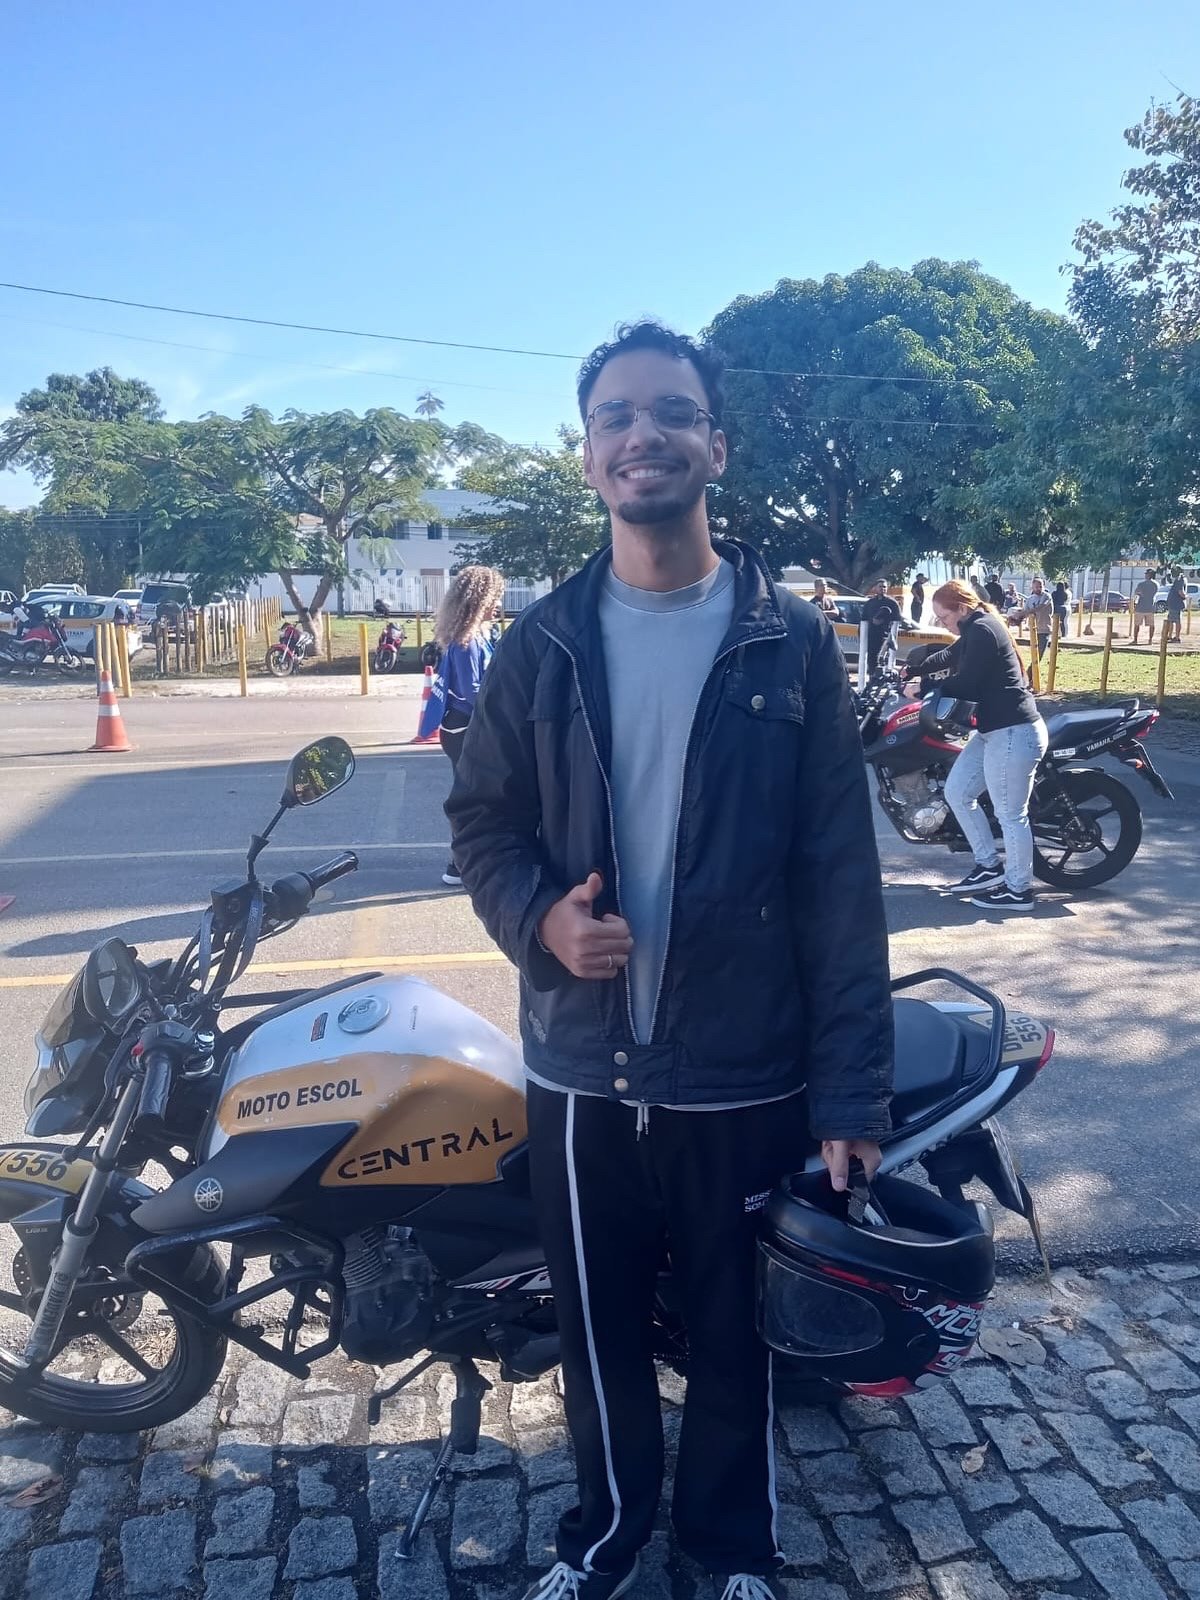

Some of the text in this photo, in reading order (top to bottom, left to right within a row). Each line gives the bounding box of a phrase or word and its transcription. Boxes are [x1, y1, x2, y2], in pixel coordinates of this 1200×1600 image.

[1086, 738, 1111, 752] YAMAHA
[237, 1079, 362, 1119] MOTO ESCOL
[337, 1118, 512, 1179] CENTRAL
